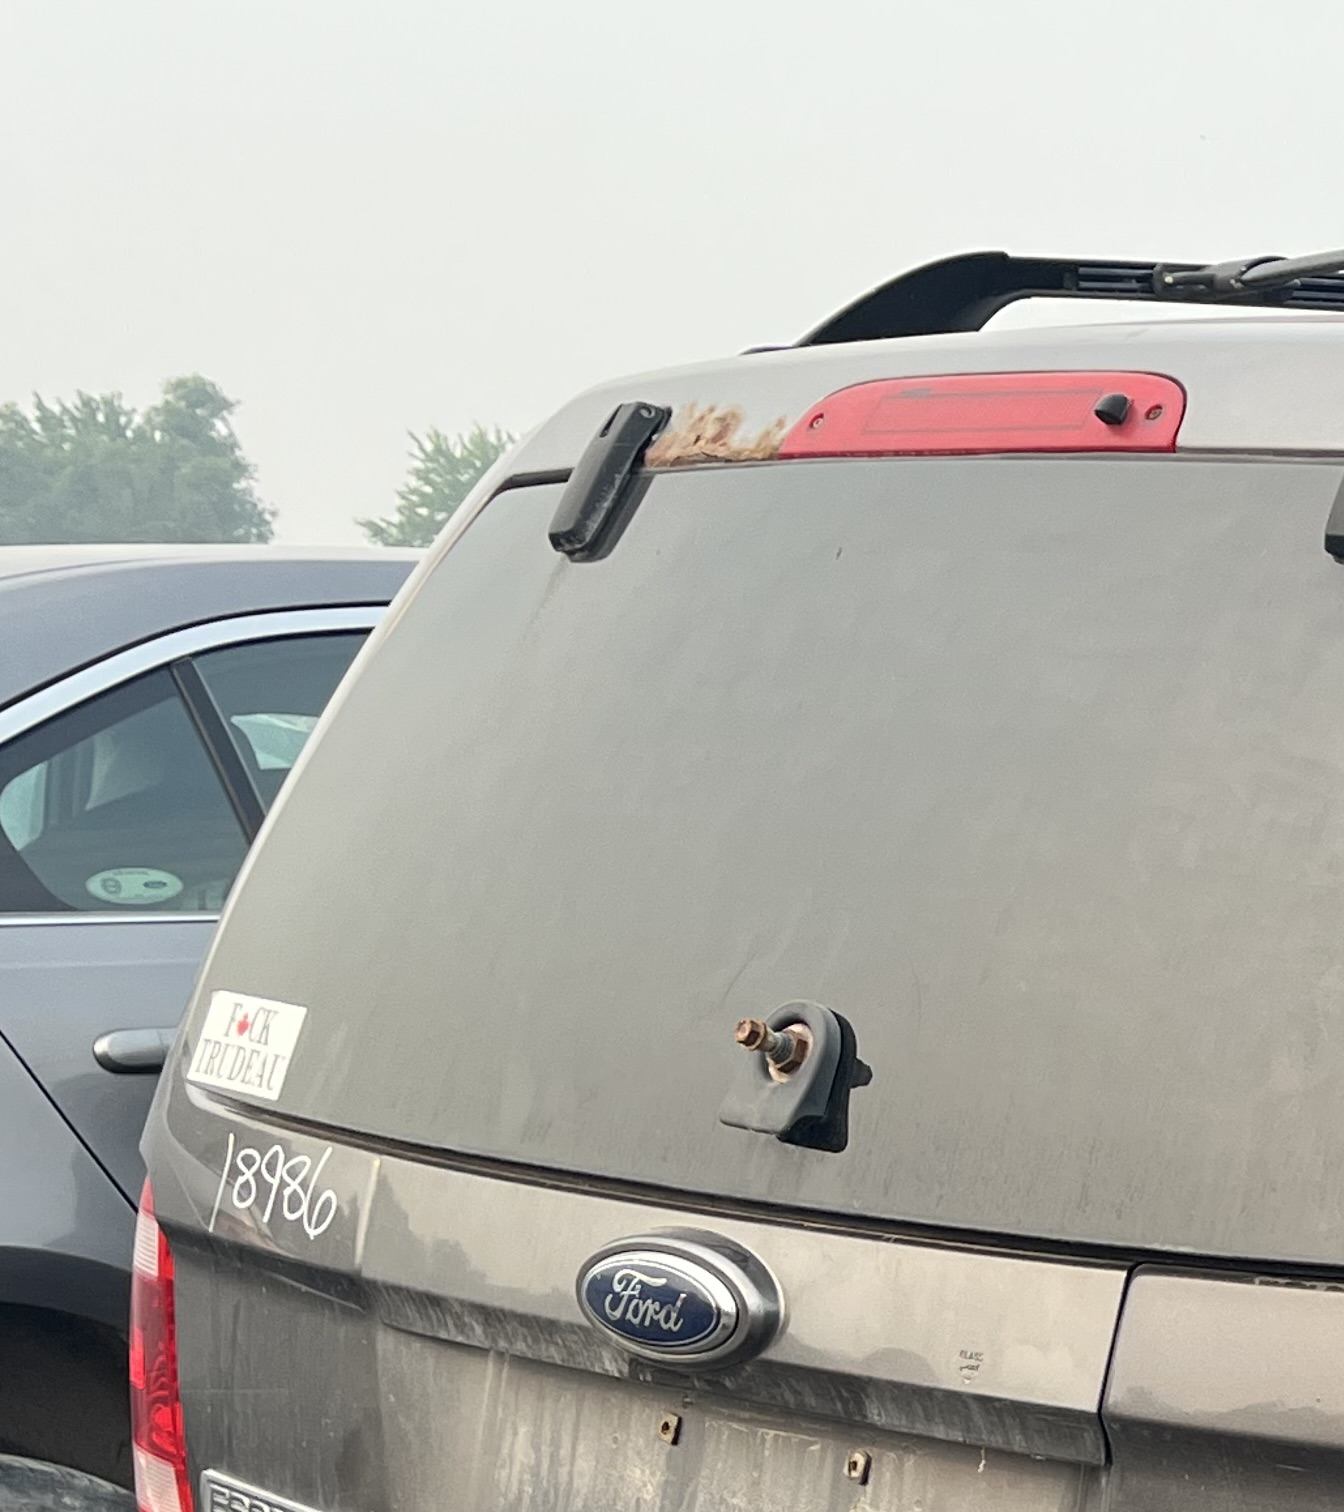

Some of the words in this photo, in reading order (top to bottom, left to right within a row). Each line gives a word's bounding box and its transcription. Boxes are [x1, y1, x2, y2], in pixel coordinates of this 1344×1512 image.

[194, 1038, 287, 1092] TRUDEAU
[208, 1132, 338, 1241] 18986
[603, 1267, 688, 1333] Ford
